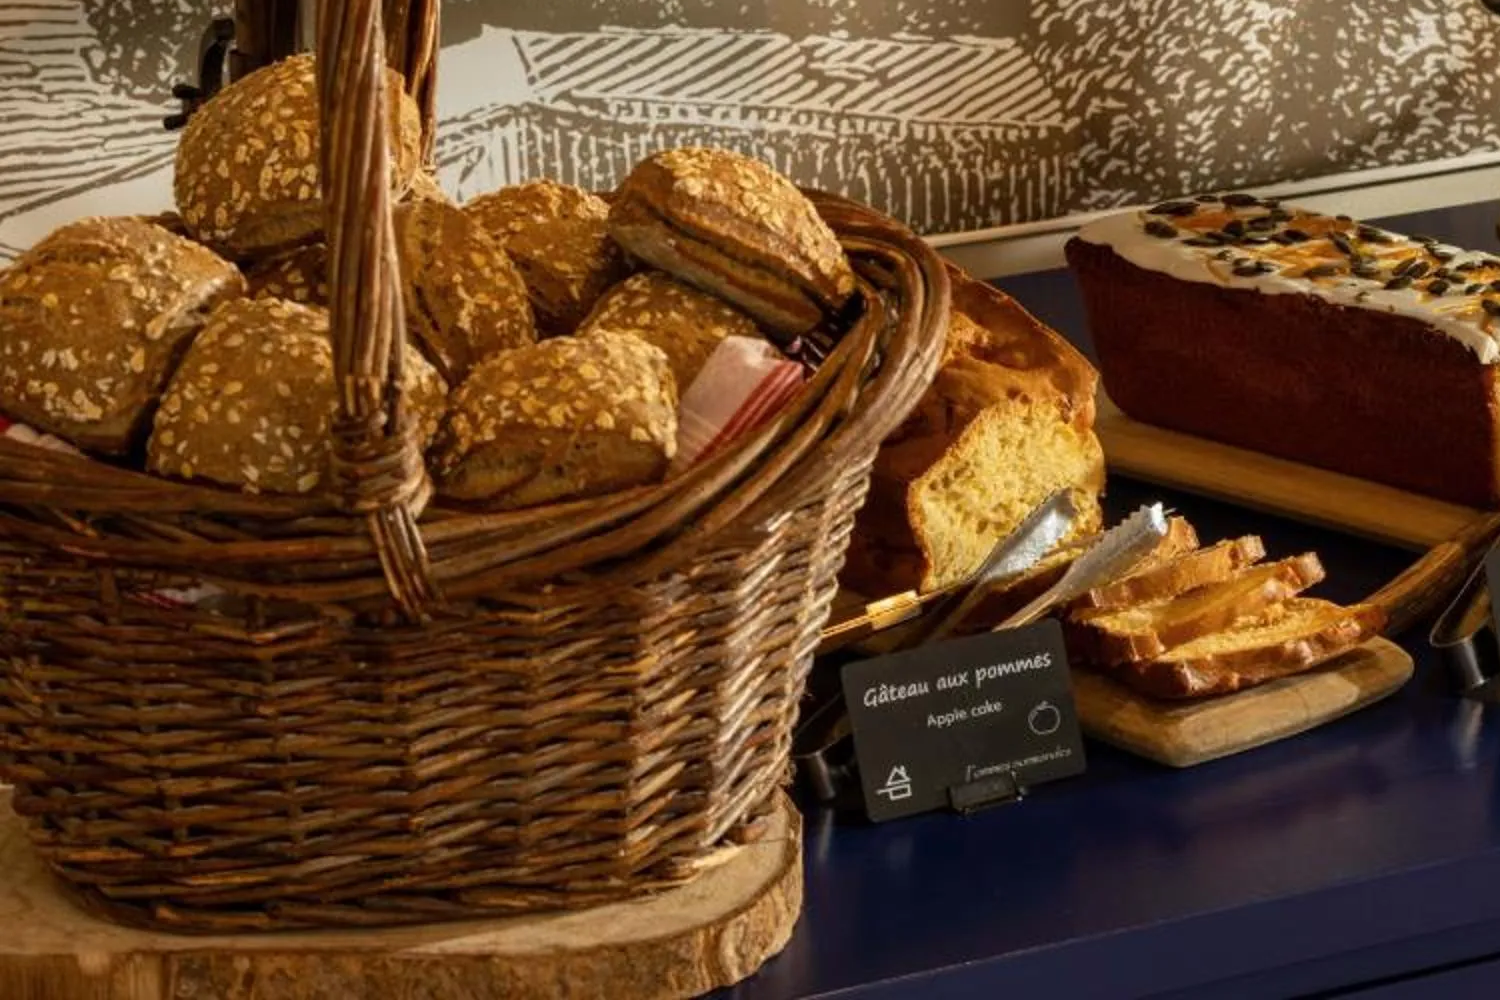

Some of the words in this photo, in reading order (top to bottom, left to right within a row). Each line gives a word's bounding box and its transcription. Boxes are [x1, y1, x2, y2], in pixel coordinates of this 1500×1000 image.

[863, 680, 929, 707] Gâteau
[936, 671, 968, 690] aux
[975, 651, 1052, 689] pommes
[927, 708, 968, 728] Apple
[971, 699, 1004, 717] cake
